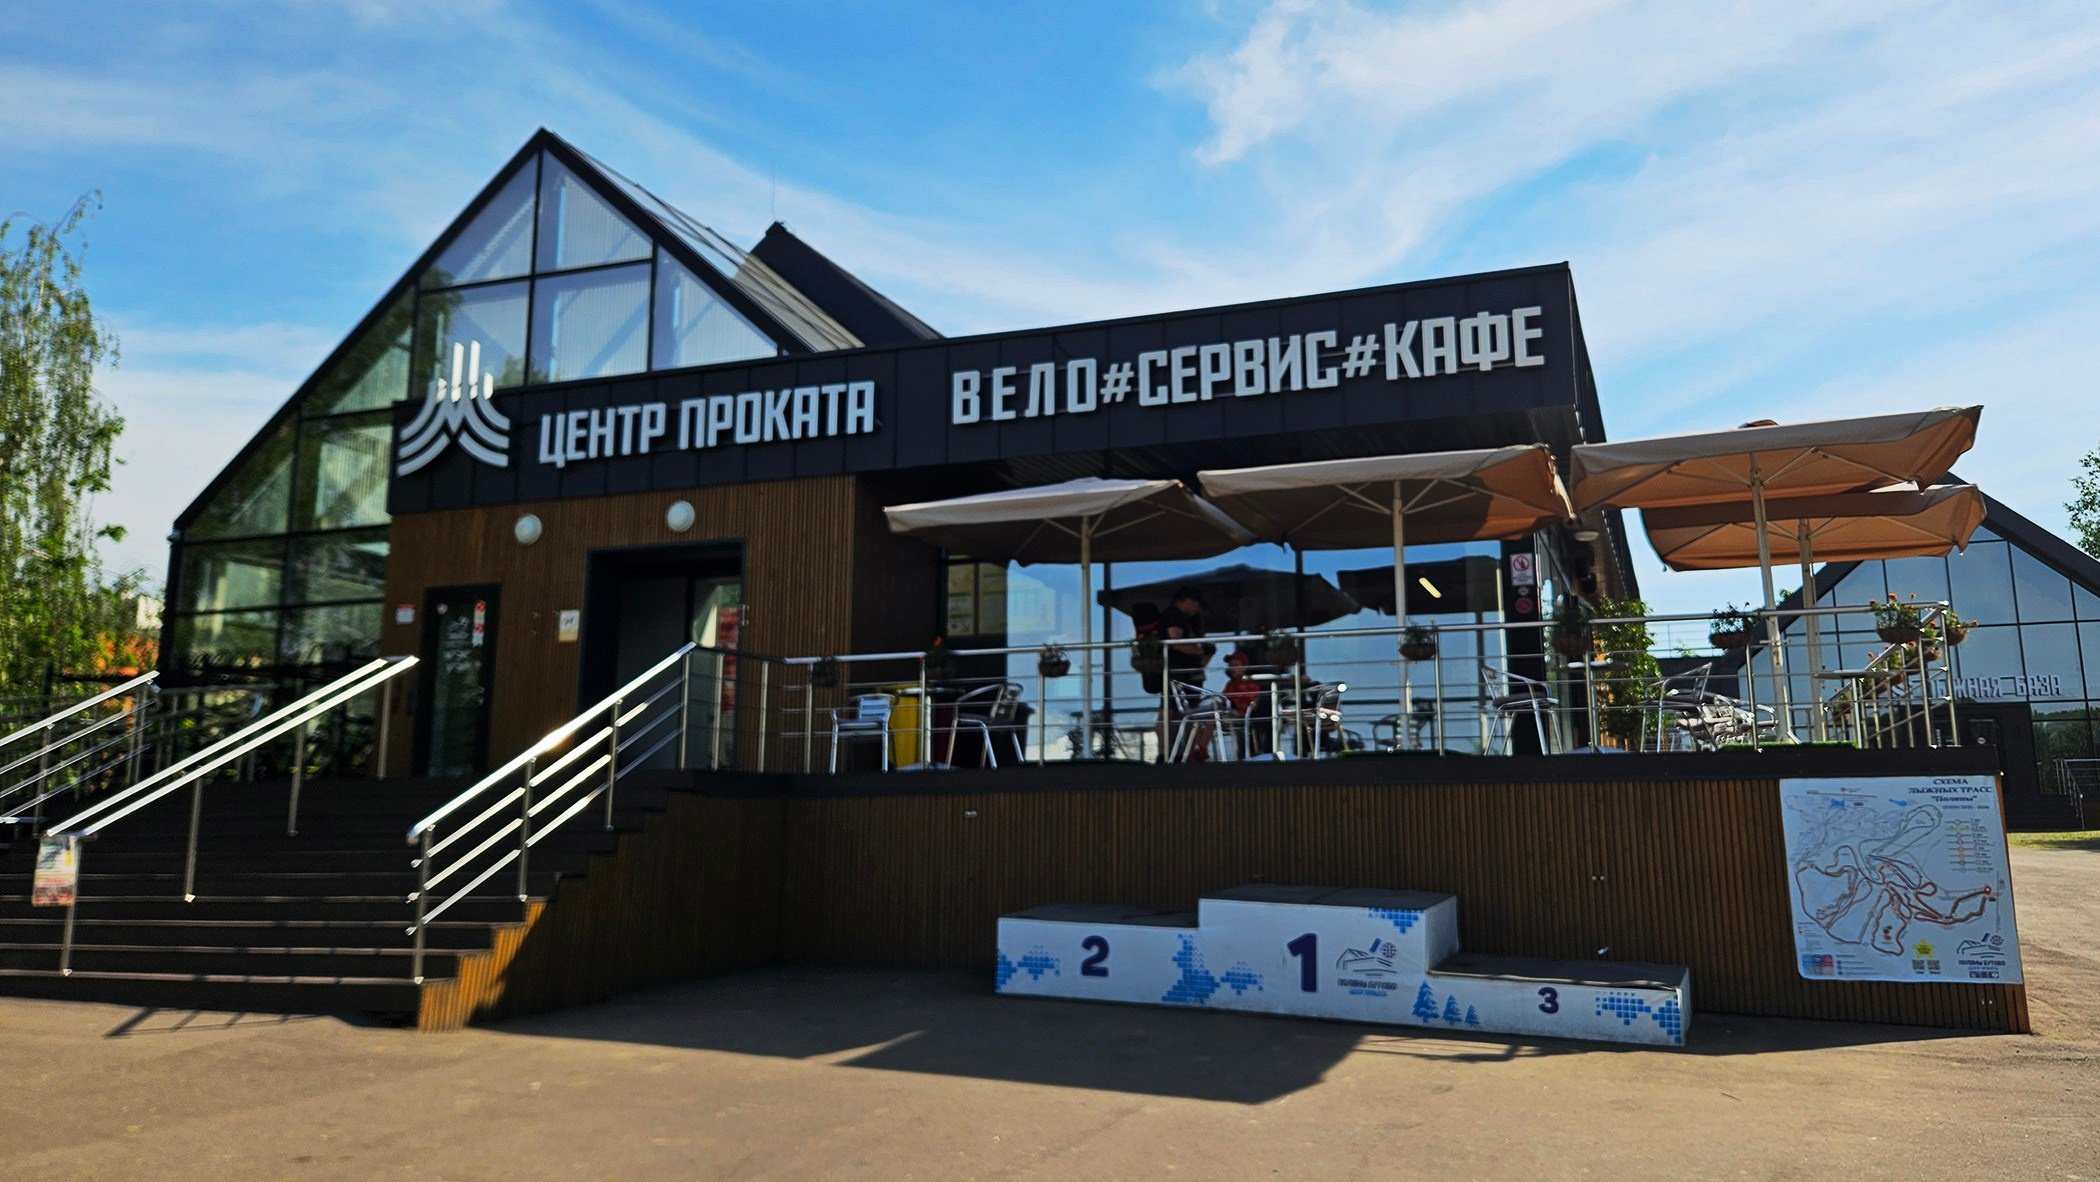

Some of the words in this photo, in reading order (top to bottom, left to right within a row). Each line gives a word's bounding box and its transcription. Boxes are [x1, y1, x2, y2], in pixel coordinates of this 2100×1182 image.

[538, 402, 668, 469] ЦЕНТР
[678, 380, 876, 450] ПРОКАТА
[2014, 676, 2062, 697] БАЗА
[1908, 786, 1958, 794] ЛЫЖНЫХ
[1080, 935, 1110, 978] 2
[1286, 932, 1319, 993] 1
[1537, 986, 1560, 1014] 3
